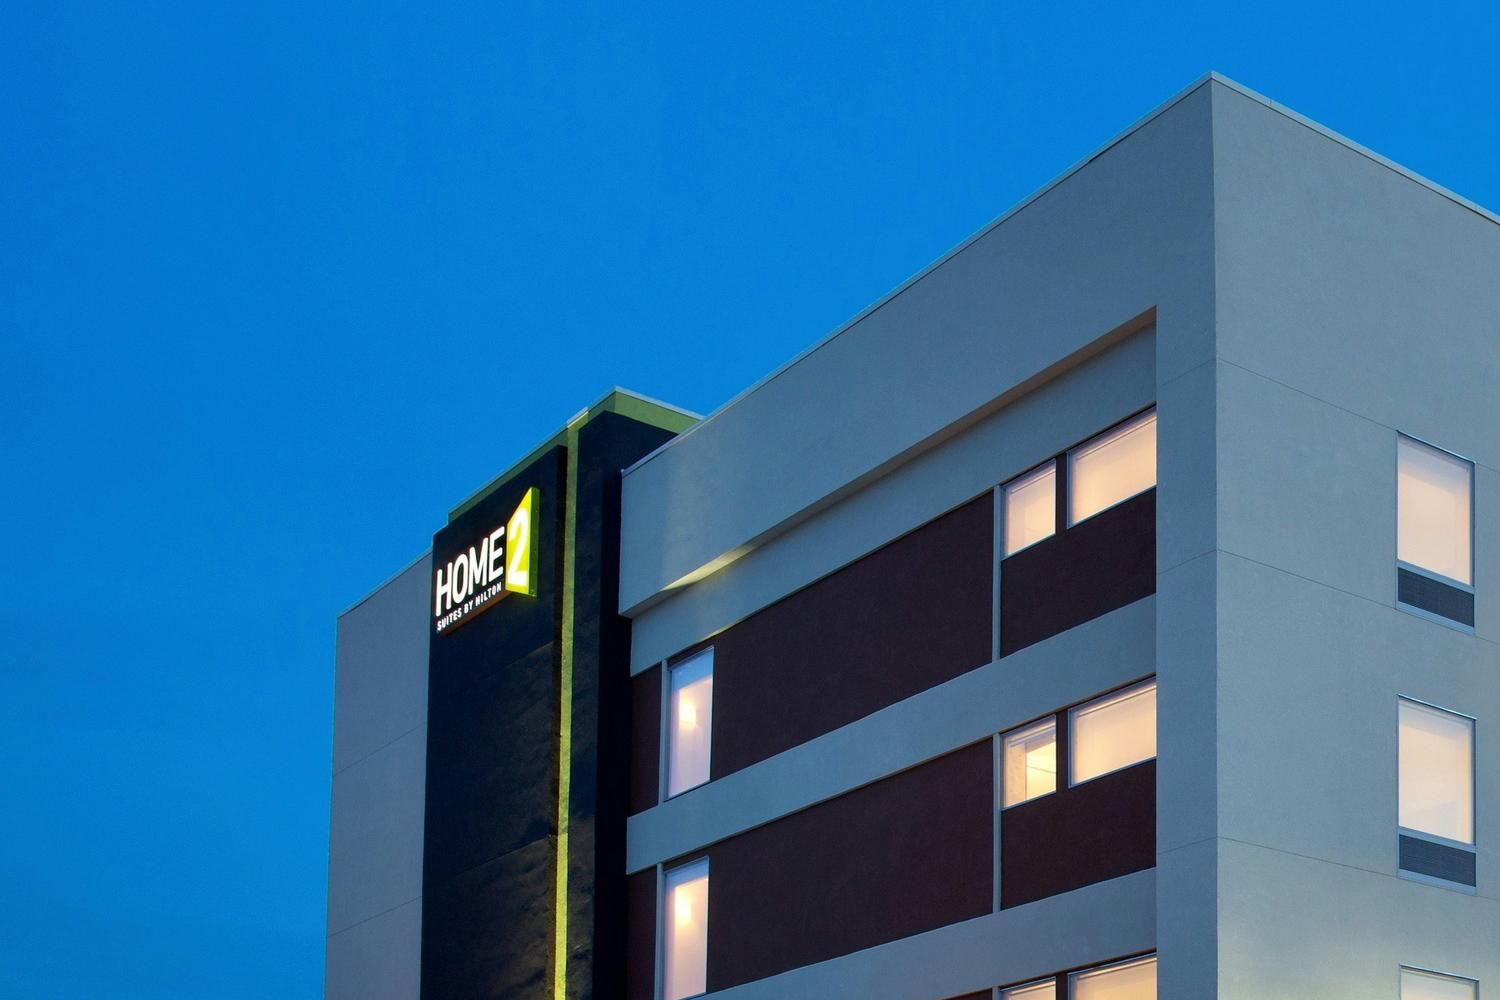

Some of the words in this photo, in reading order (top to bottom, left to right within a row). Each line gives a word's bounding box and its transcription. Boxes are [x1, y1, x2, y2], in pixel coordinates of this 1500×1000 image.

[437, 607, 462, 631] SUITES
[464, 600, 473, 614] BY
[475, 582, 501, 606] HILTON
